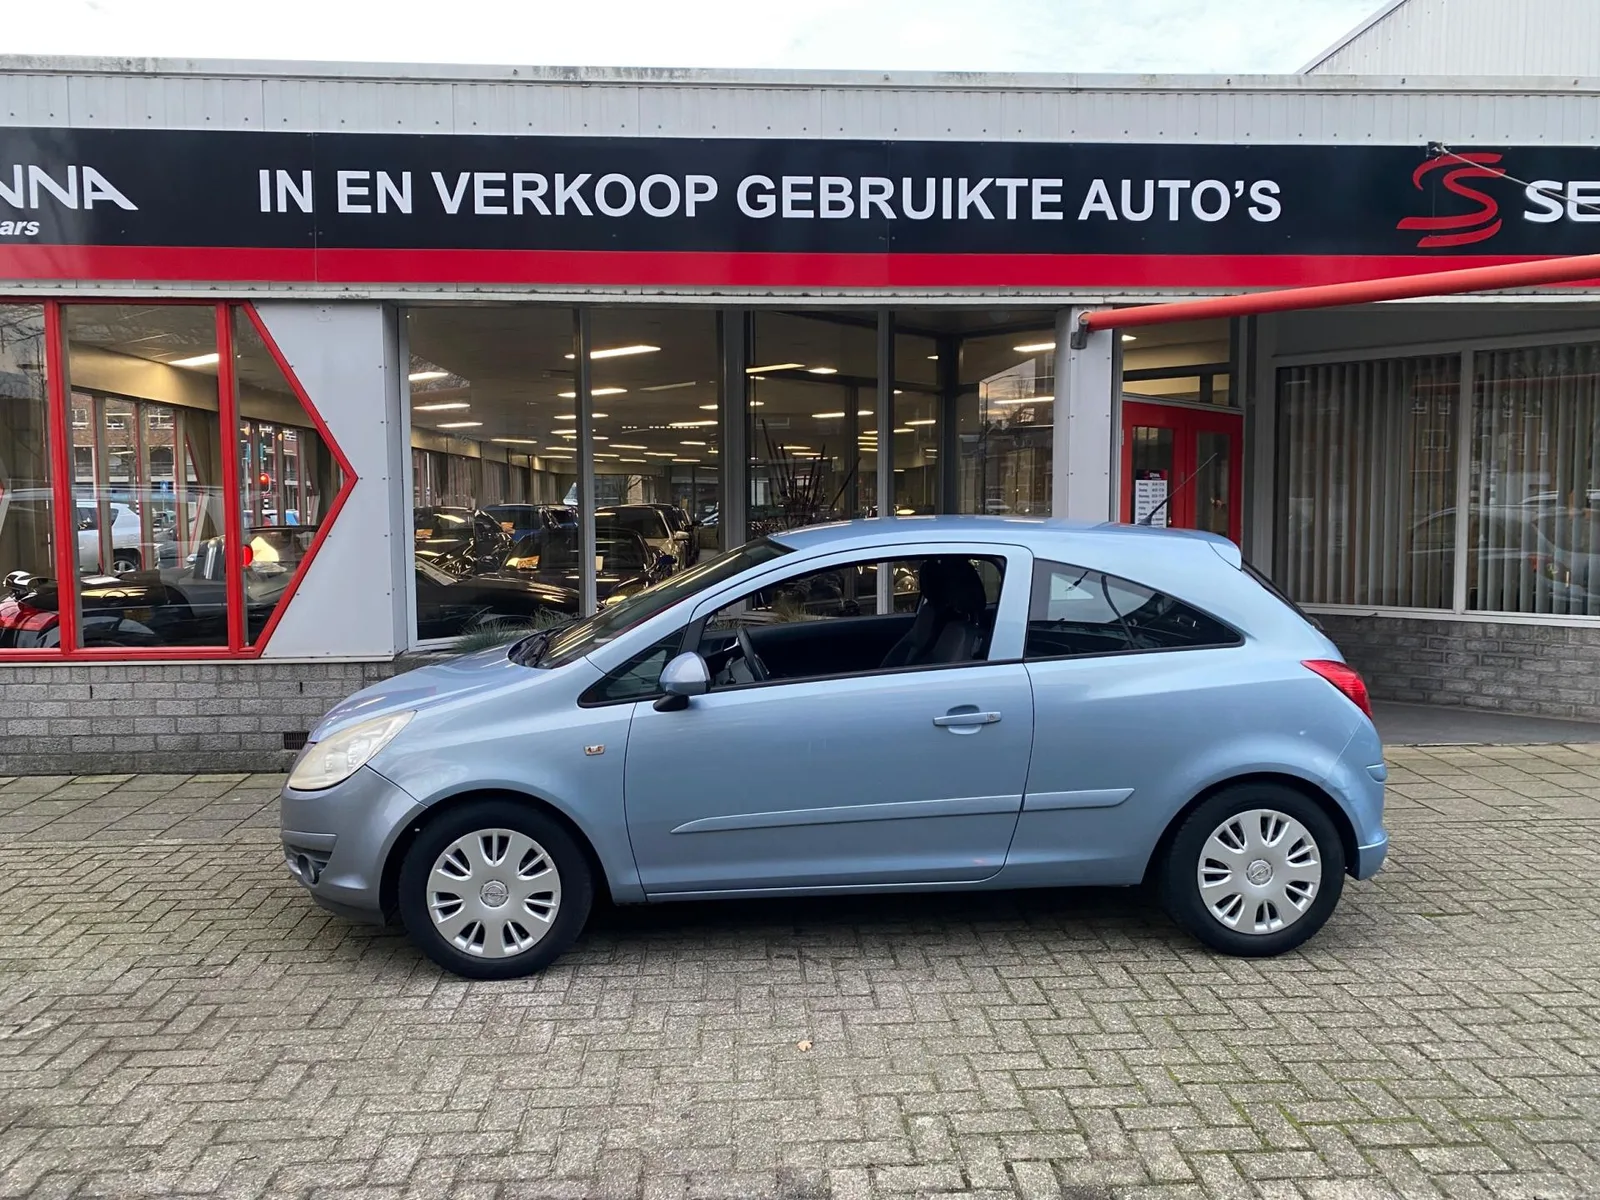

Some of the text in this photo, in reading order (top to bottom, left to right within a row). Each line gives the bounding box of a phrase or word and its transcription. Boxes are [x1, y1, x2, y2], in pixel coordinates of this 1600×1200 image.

[259, 169, 1282, 222] IN EN VERKOOP GEBRUIKTE AUTO'S
[1523, 179, 1600, 223] SE
[0, 220, 40, 236] ars
